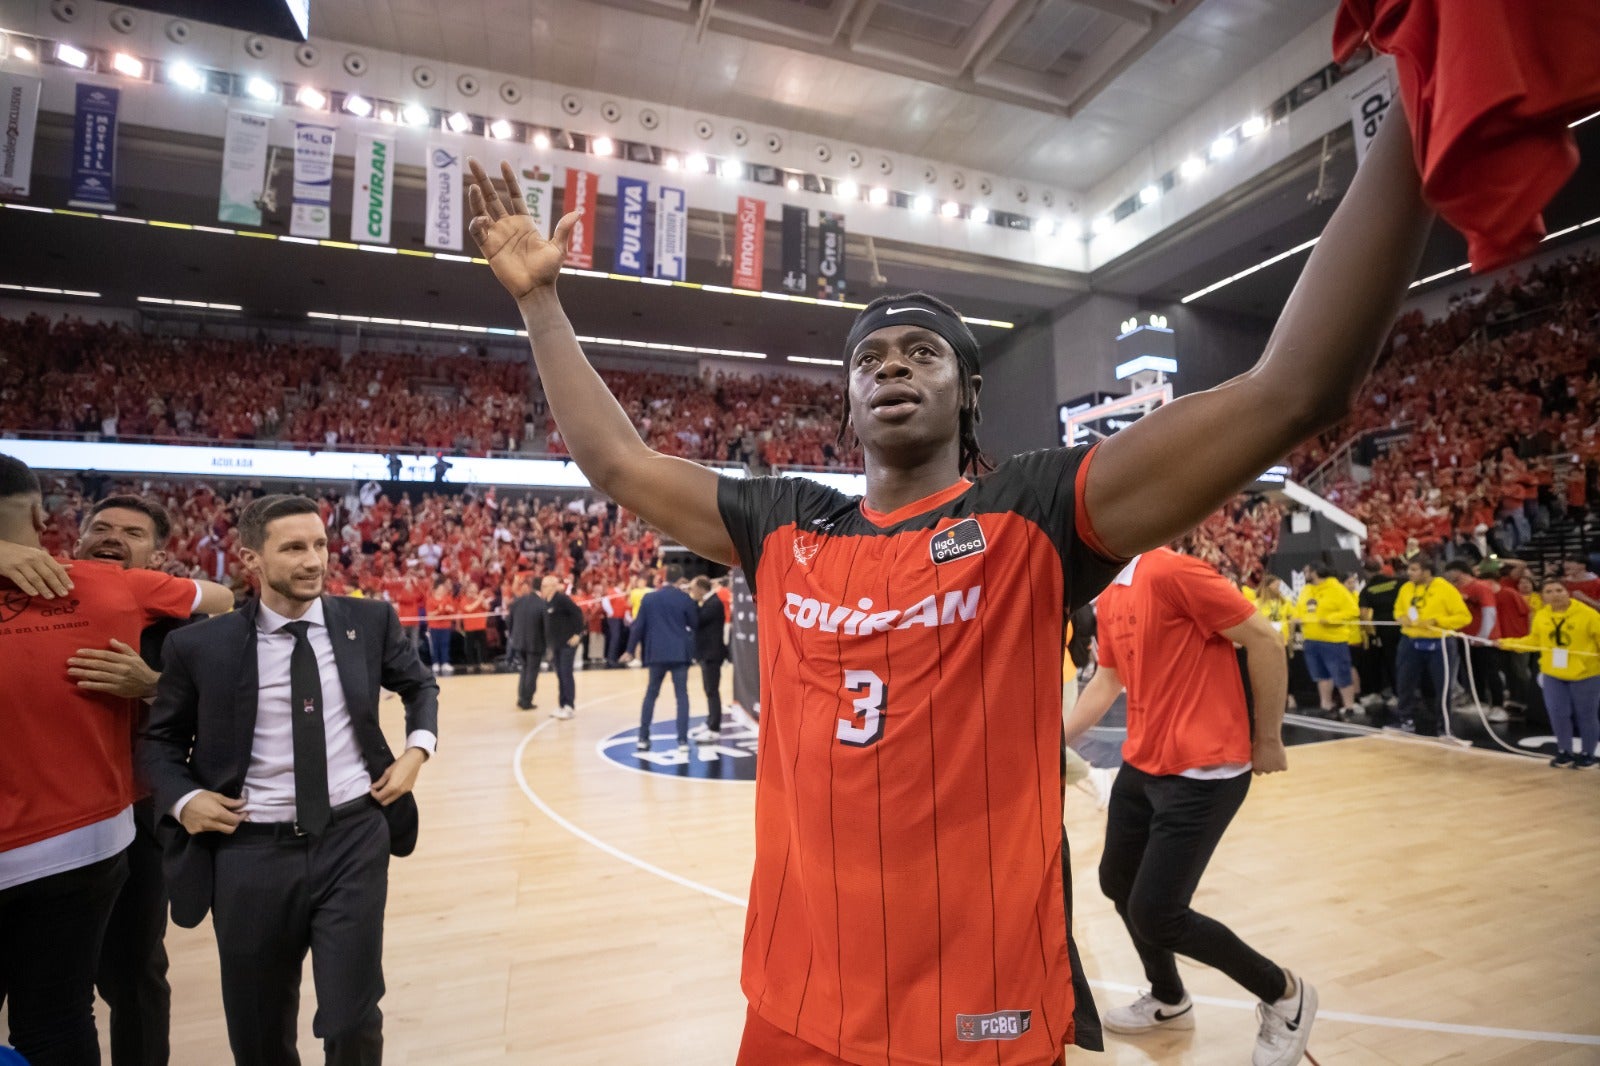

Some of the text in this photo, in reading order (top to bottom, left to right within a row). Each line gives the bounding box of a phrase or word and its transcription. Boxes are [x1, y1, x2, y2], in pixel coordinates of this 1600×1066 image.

[368, 141, 386, 237] COVIRAN
[435, 172, 450, 246] emasagra
[620, 186, 643, 269] PULEVA
[934, 538, 955, 551] liga
[937, 539, 982, 559] endesa
[15, 626, 33, 634] en
[35, 624, 49, 632] tu
[53, 620, 89, 631] mano
[836, 669, 888, 748] 3
[981, 1016, 1018, 1036] FCBG
